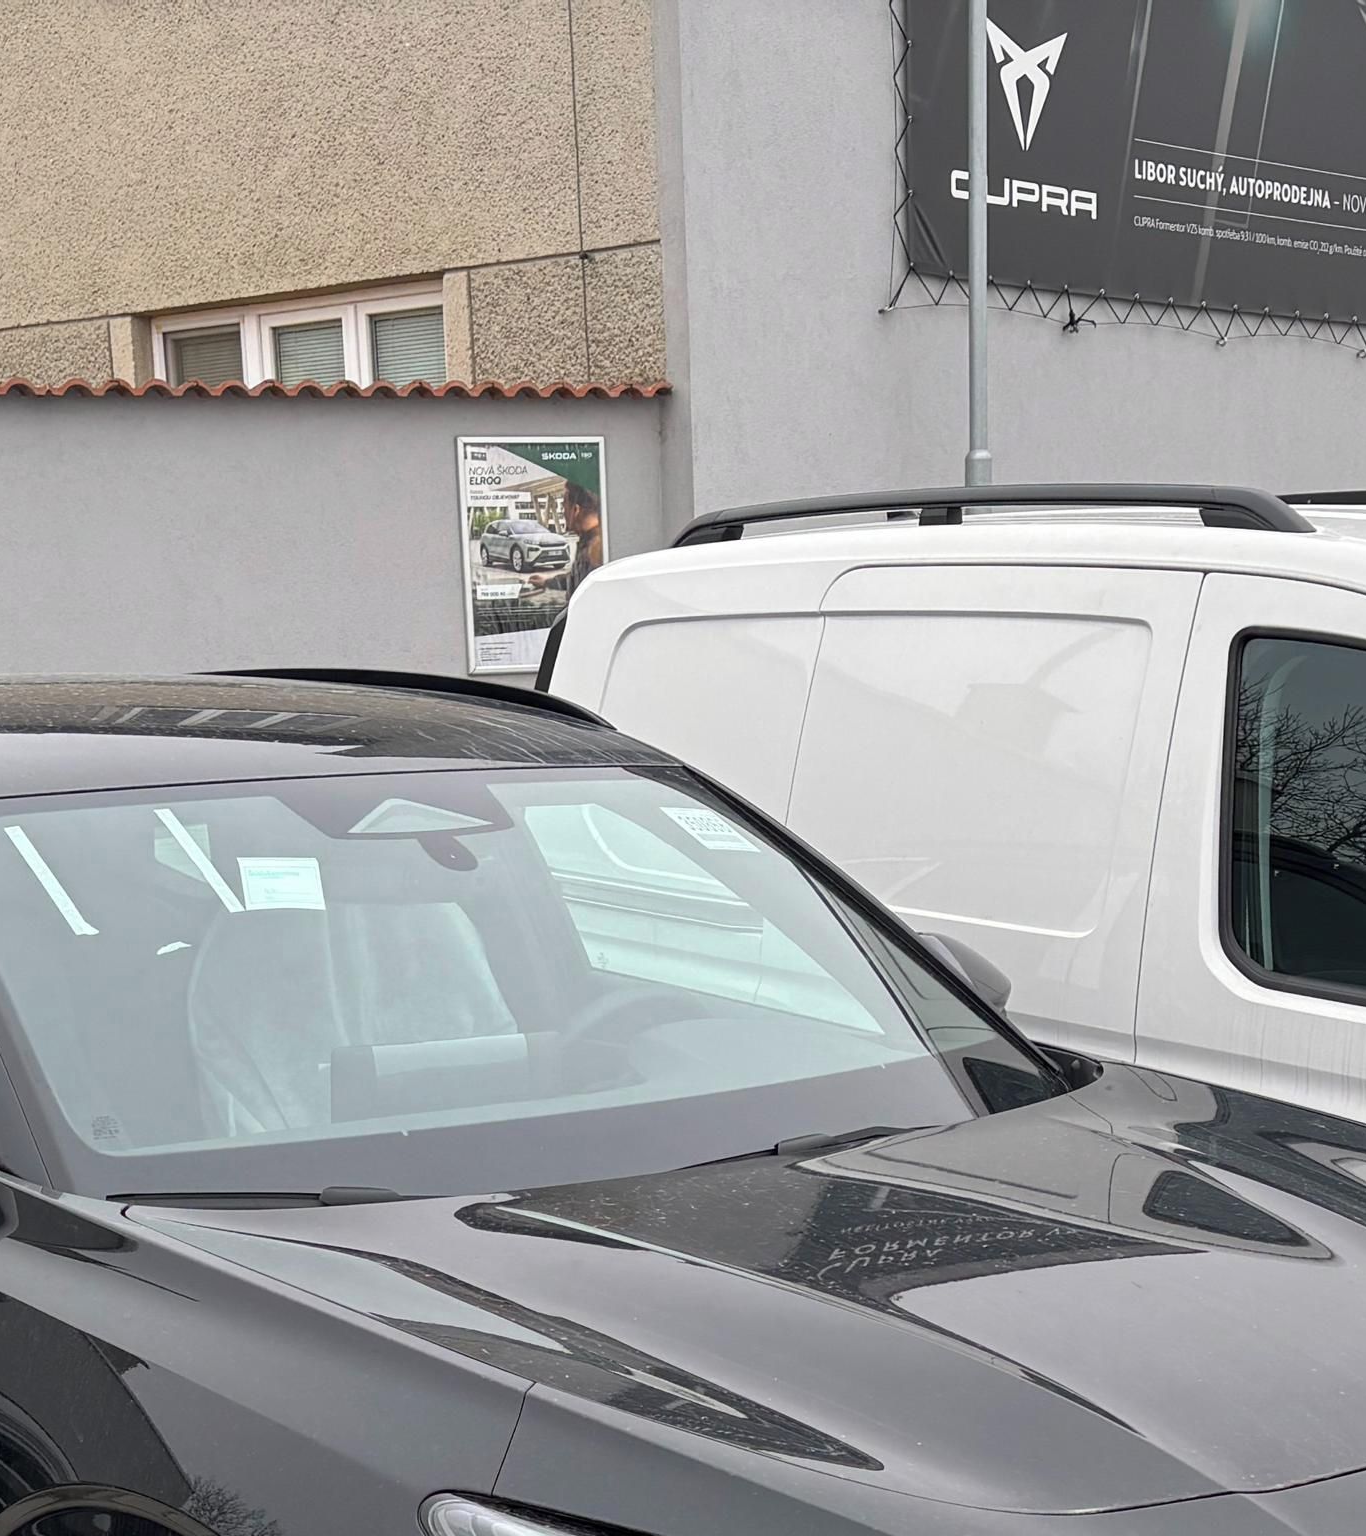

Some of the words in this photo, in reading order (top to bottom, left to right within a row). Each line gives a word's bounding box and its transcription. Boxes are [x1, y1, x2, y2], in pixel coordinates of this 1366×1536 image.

[950, 169, 1098, 220] CUPRA
[1134, 158, 1176, 185] LIBOR
[1179, 165, 1227, 196] SUCHÝ,
[1229, 175, 1332, 209] AUTOPRODEJNA
[1134, 215, 1155, 228] CUPRA
